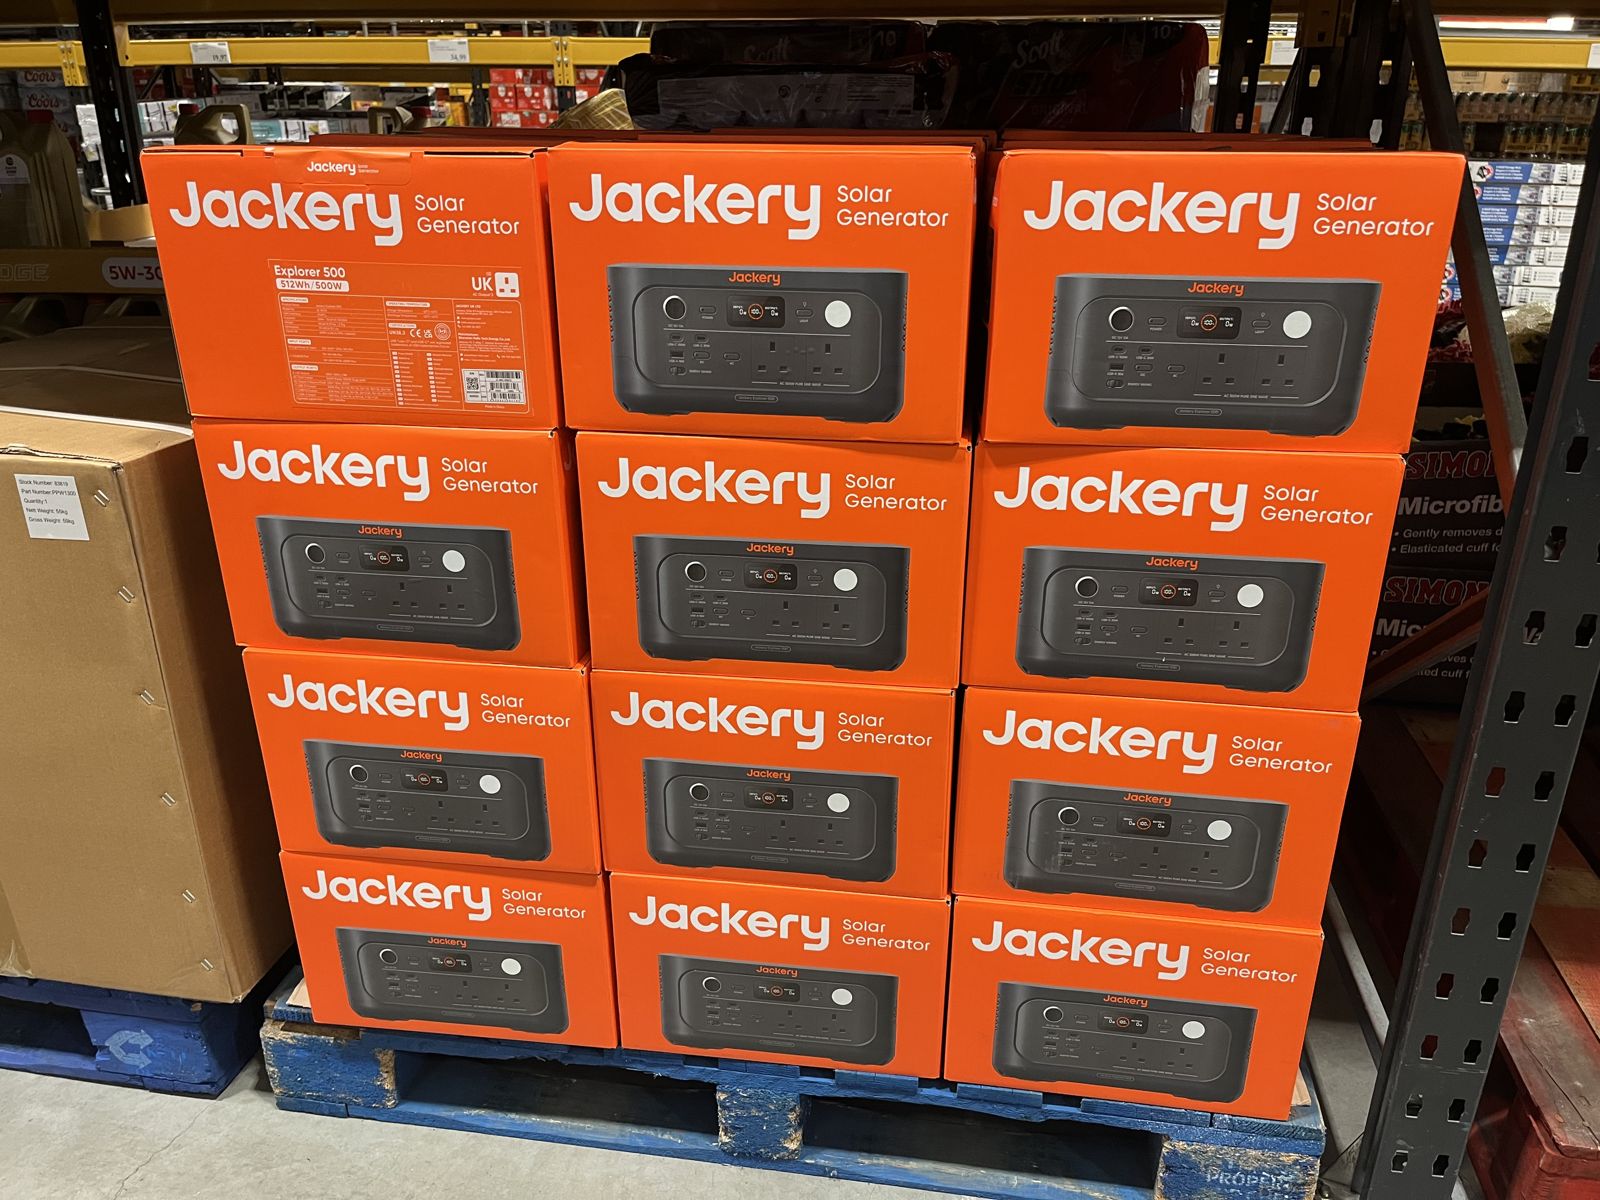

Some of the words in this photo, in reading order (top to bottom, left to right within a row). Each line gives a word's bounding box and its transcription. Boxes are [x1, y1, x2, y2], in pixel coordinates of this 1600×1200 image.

[306, 161, 357, 176] Jackery
[838, 186, 892, 202] Solar
[1317, 193, 1376, 211] Solar
[415, 195, 464, 211] Solar
[570, 174, 820, 240] Jackery
[170, 182, 403, 246] Jackery
[837, 209, 948, 226] Generator
[1024, 181, 1300, 249] Jackery
[417, 217, 519, 234] Generator
[1314, 217, 1434, 236] Generator
[273, 265, 320, 278] Explorer
[323, 267, 346, 278] 500
[729, 272, 781, 286] Jackery
[280, 279, 342, 290] 512Wh/500W
[471, 276, 493, 291] UK
[1188, 282, 1245, 297] Jackery
[218, 441, 430, 501] Jackery
[442, 458, 487, 472] Solar
[1405, 450, 1496, 480] SIMO
[444, 477, 537, 493] Generator
[598, 458, 830, 518] Jackery
[846, 474, 895, 489] Solar
[994, 467, 1248, 531] Jackery
[1264, 485, 1318, 501] Solar
[845, 494, 946, 510] Generator
[1261, 506, 1373, 524] Generator
[358, 525, 403, 538] Jackery
[1403, 528, 1440, 539] Gently
[1442, 528, 1492, 537] removes
[746, 544, 794, 556] Jackery
[1400, 544, 1464, 554] Elasticated
[1466, 542, 1489, 552] cuff
[1146, 557, 1199, 571] Jackery
[1441, 669, 1464, 679] cuff
[268, 675, 469, 731] Jackery
[481, 694, 523, 707] Solar
[482, 710, 569, 727] Generator
[611, 692, 824, 750] Jackery
[839, 713, 884, 726] Solar
[838, 730, 932, 746] Generator
[983, 710, 1217, 774] Jackery
[1232, 736, 1282, 751] Solar
[400, 750, 443, 763] Jackery
[1230, 754, 1332, 773] Generator
[747, 769, 791, 782] Jackery
[1123, 793, 1172, 807] Jackery
[302, 870, 491, 921] Jackery
[502, 889, 542, 901] Solar
[504, 903, 585, 918] Generator
[629, 896, 829, 951] Jackery
[843, 919, 885, 932] Solar
[427, 937, 467, 949] Jackery
[843, 934, 929, 950] Generator
[972, 921, 1189, 980] Jackery
[1204, 948, 1250, 962] Solar
[756, 966, 798, 978] Jackery
[1201, 963, 1297, 982] Generator
[1103, 994, 1148, 1008] Jackery
